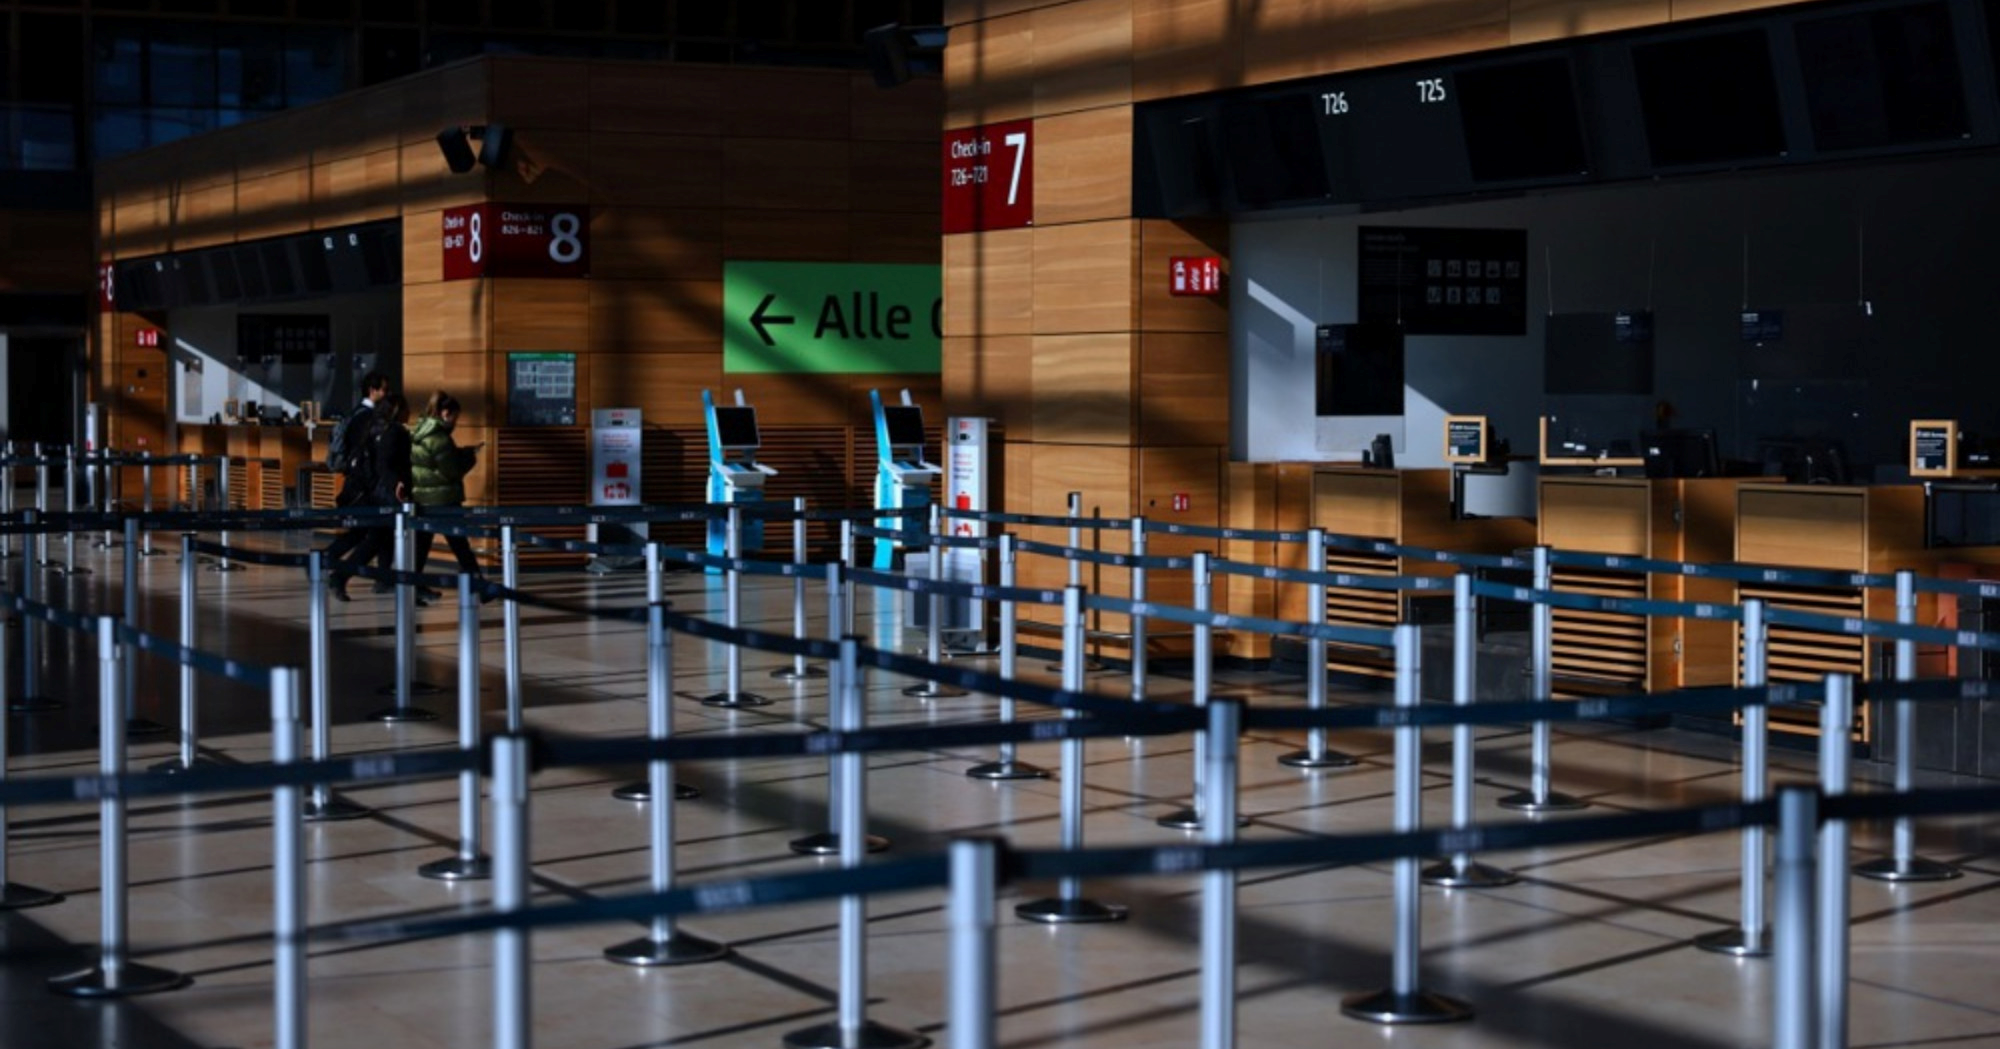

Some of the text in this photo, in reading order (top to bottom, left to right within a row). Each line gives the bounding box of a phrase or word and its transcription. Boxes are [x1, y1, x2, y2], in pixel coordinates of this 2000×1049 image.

[1321, 91, 1349, 115] 726
[1415, 78, 1446, 103] 725
[951, 138, 991, 158] Check-in
[1005, 132, 1026, 205] 7
[469, 212, 482, 263] 8
[549, 212, 582, 263] 8
[814, 291, 910, 339] Alle
